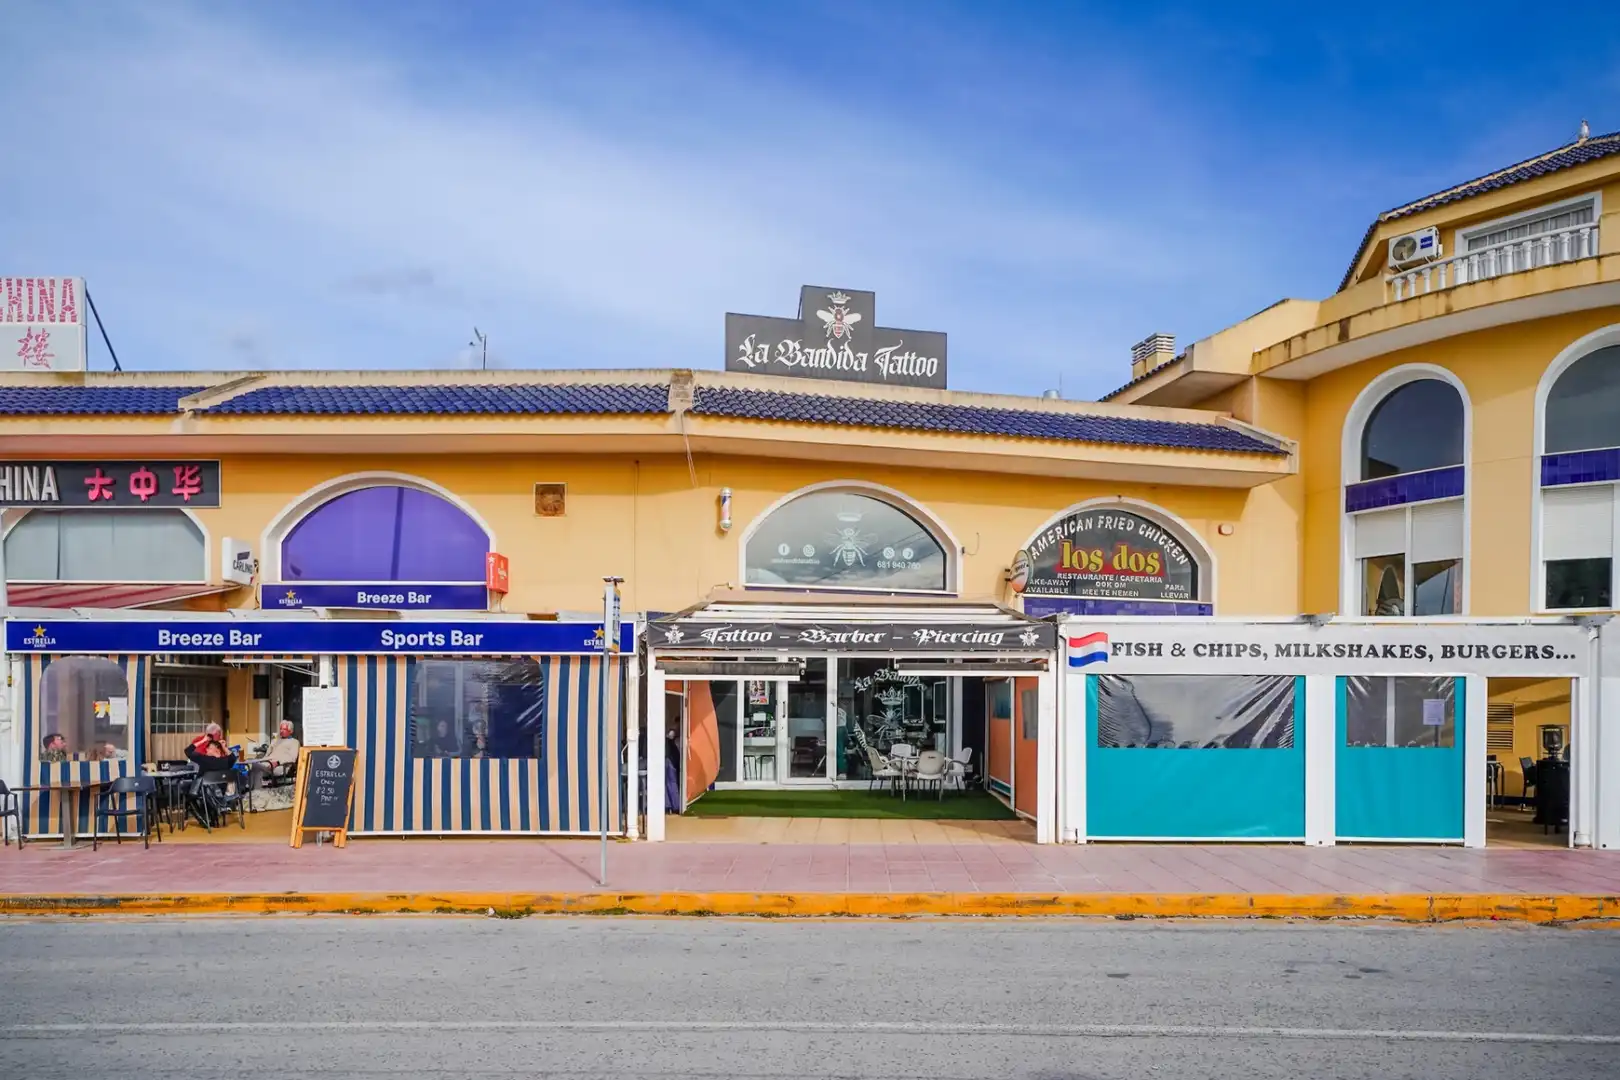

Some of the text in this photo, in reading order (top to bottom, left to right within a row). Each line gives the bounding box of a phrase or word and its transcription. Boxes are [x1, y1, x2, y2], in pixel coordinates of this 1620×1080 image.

[0, 278, 77, 322] HINA
[736, 334, 938, 380] La Bandida Tattoo
[0, 466, 59, 501] HINA
[84, 466, 201, 501] 大中华
[1031, 515, 1189, 565] AMERICAN FRIED CHICKEN
[1060, 540, 1161, 575] los dos
[232, 560, 253, 575] CARLING
[1029, 578, 1070, 587] AKE-AWAY
[1057, 572, 1114, 581] RESTAURANTE
[1120, 574, 1163, 584] CAFETARIA
[1025, 586, 1069, 595] AVAILABLE
[1082, 588, 1139, 598] MEE TE NEMEN
[1160, 591, 1189, 600] LLEVAR
[1164, 583, 1185, 592] PARA
[357, 591, 432, 604] Breeze Bar
[23, 637, 56, 645] ESTRELLA
[158, 629, 262, 646] Breeze Bar
[381, 629, 483, 649] Sports Bar
[700, 624, 773, 646] Tattoo
[796, 624, 887, 645] Barber
[911, 628, 1004, 646] Piercing
[1111, 642, 1576, 662] FISH & CHIPS, MILKSHAKES, BURGERS...
